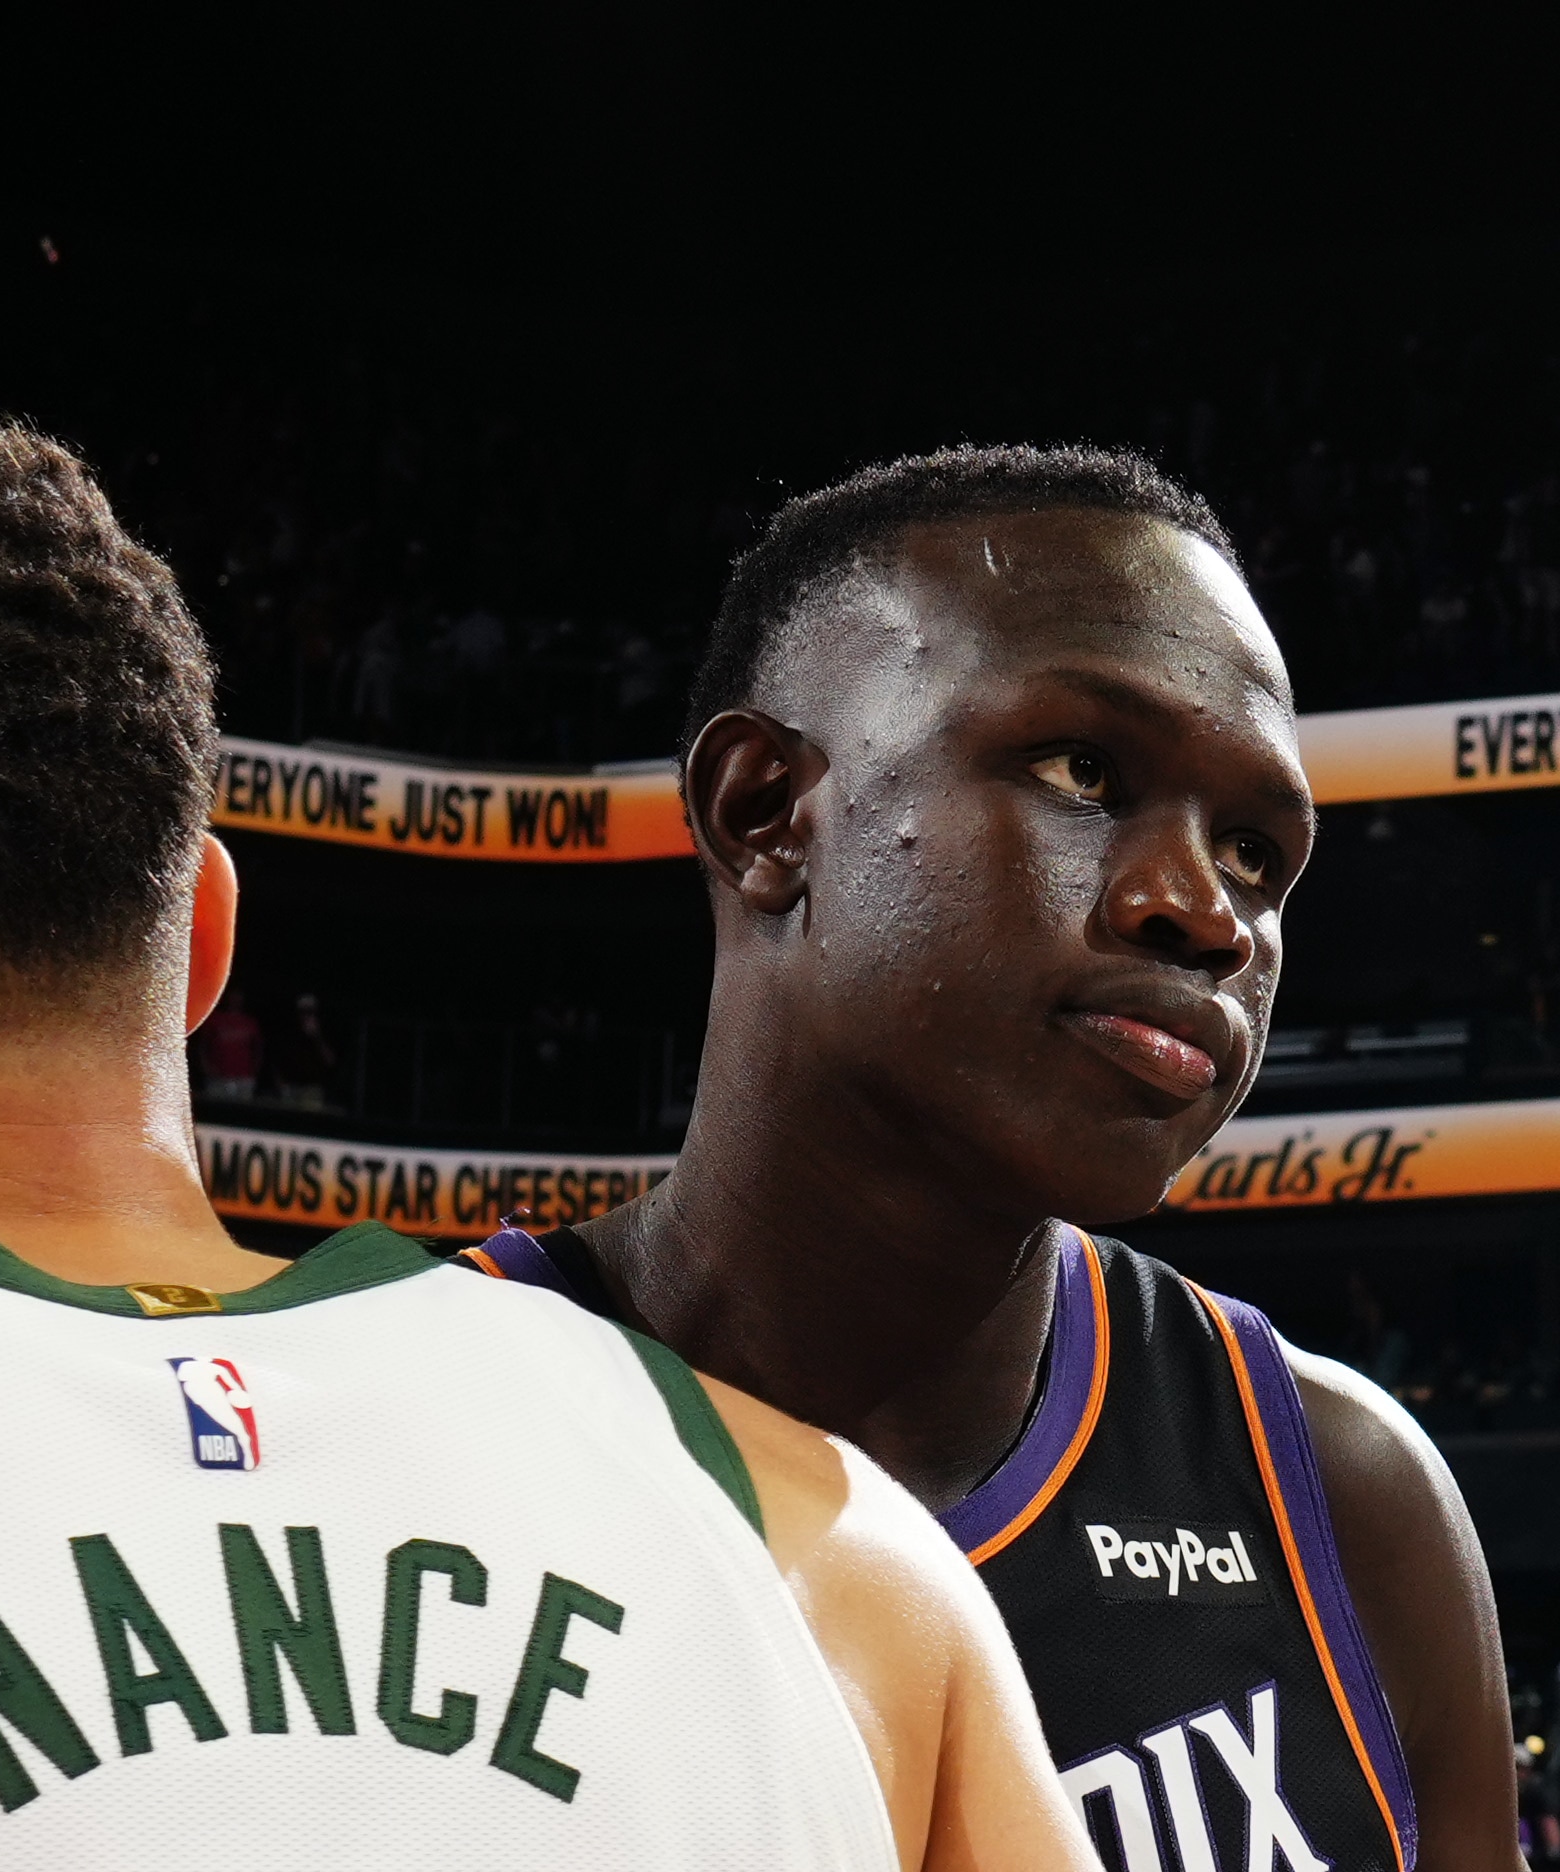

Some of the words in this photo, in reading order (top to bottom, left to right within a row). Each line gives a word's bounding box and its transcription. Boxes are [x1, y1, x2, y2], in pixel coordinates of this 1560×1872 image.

[388, 779, 492, 846] JUST
[505, 786, 609, 849] WON!
[337, 1152, 440, 1222] STAR
[1196, 1128, 1325, 1200] arl's
[197, 1435, 239, 1463] NBA
[1085, 1524, 1258, 1597] PayPal
